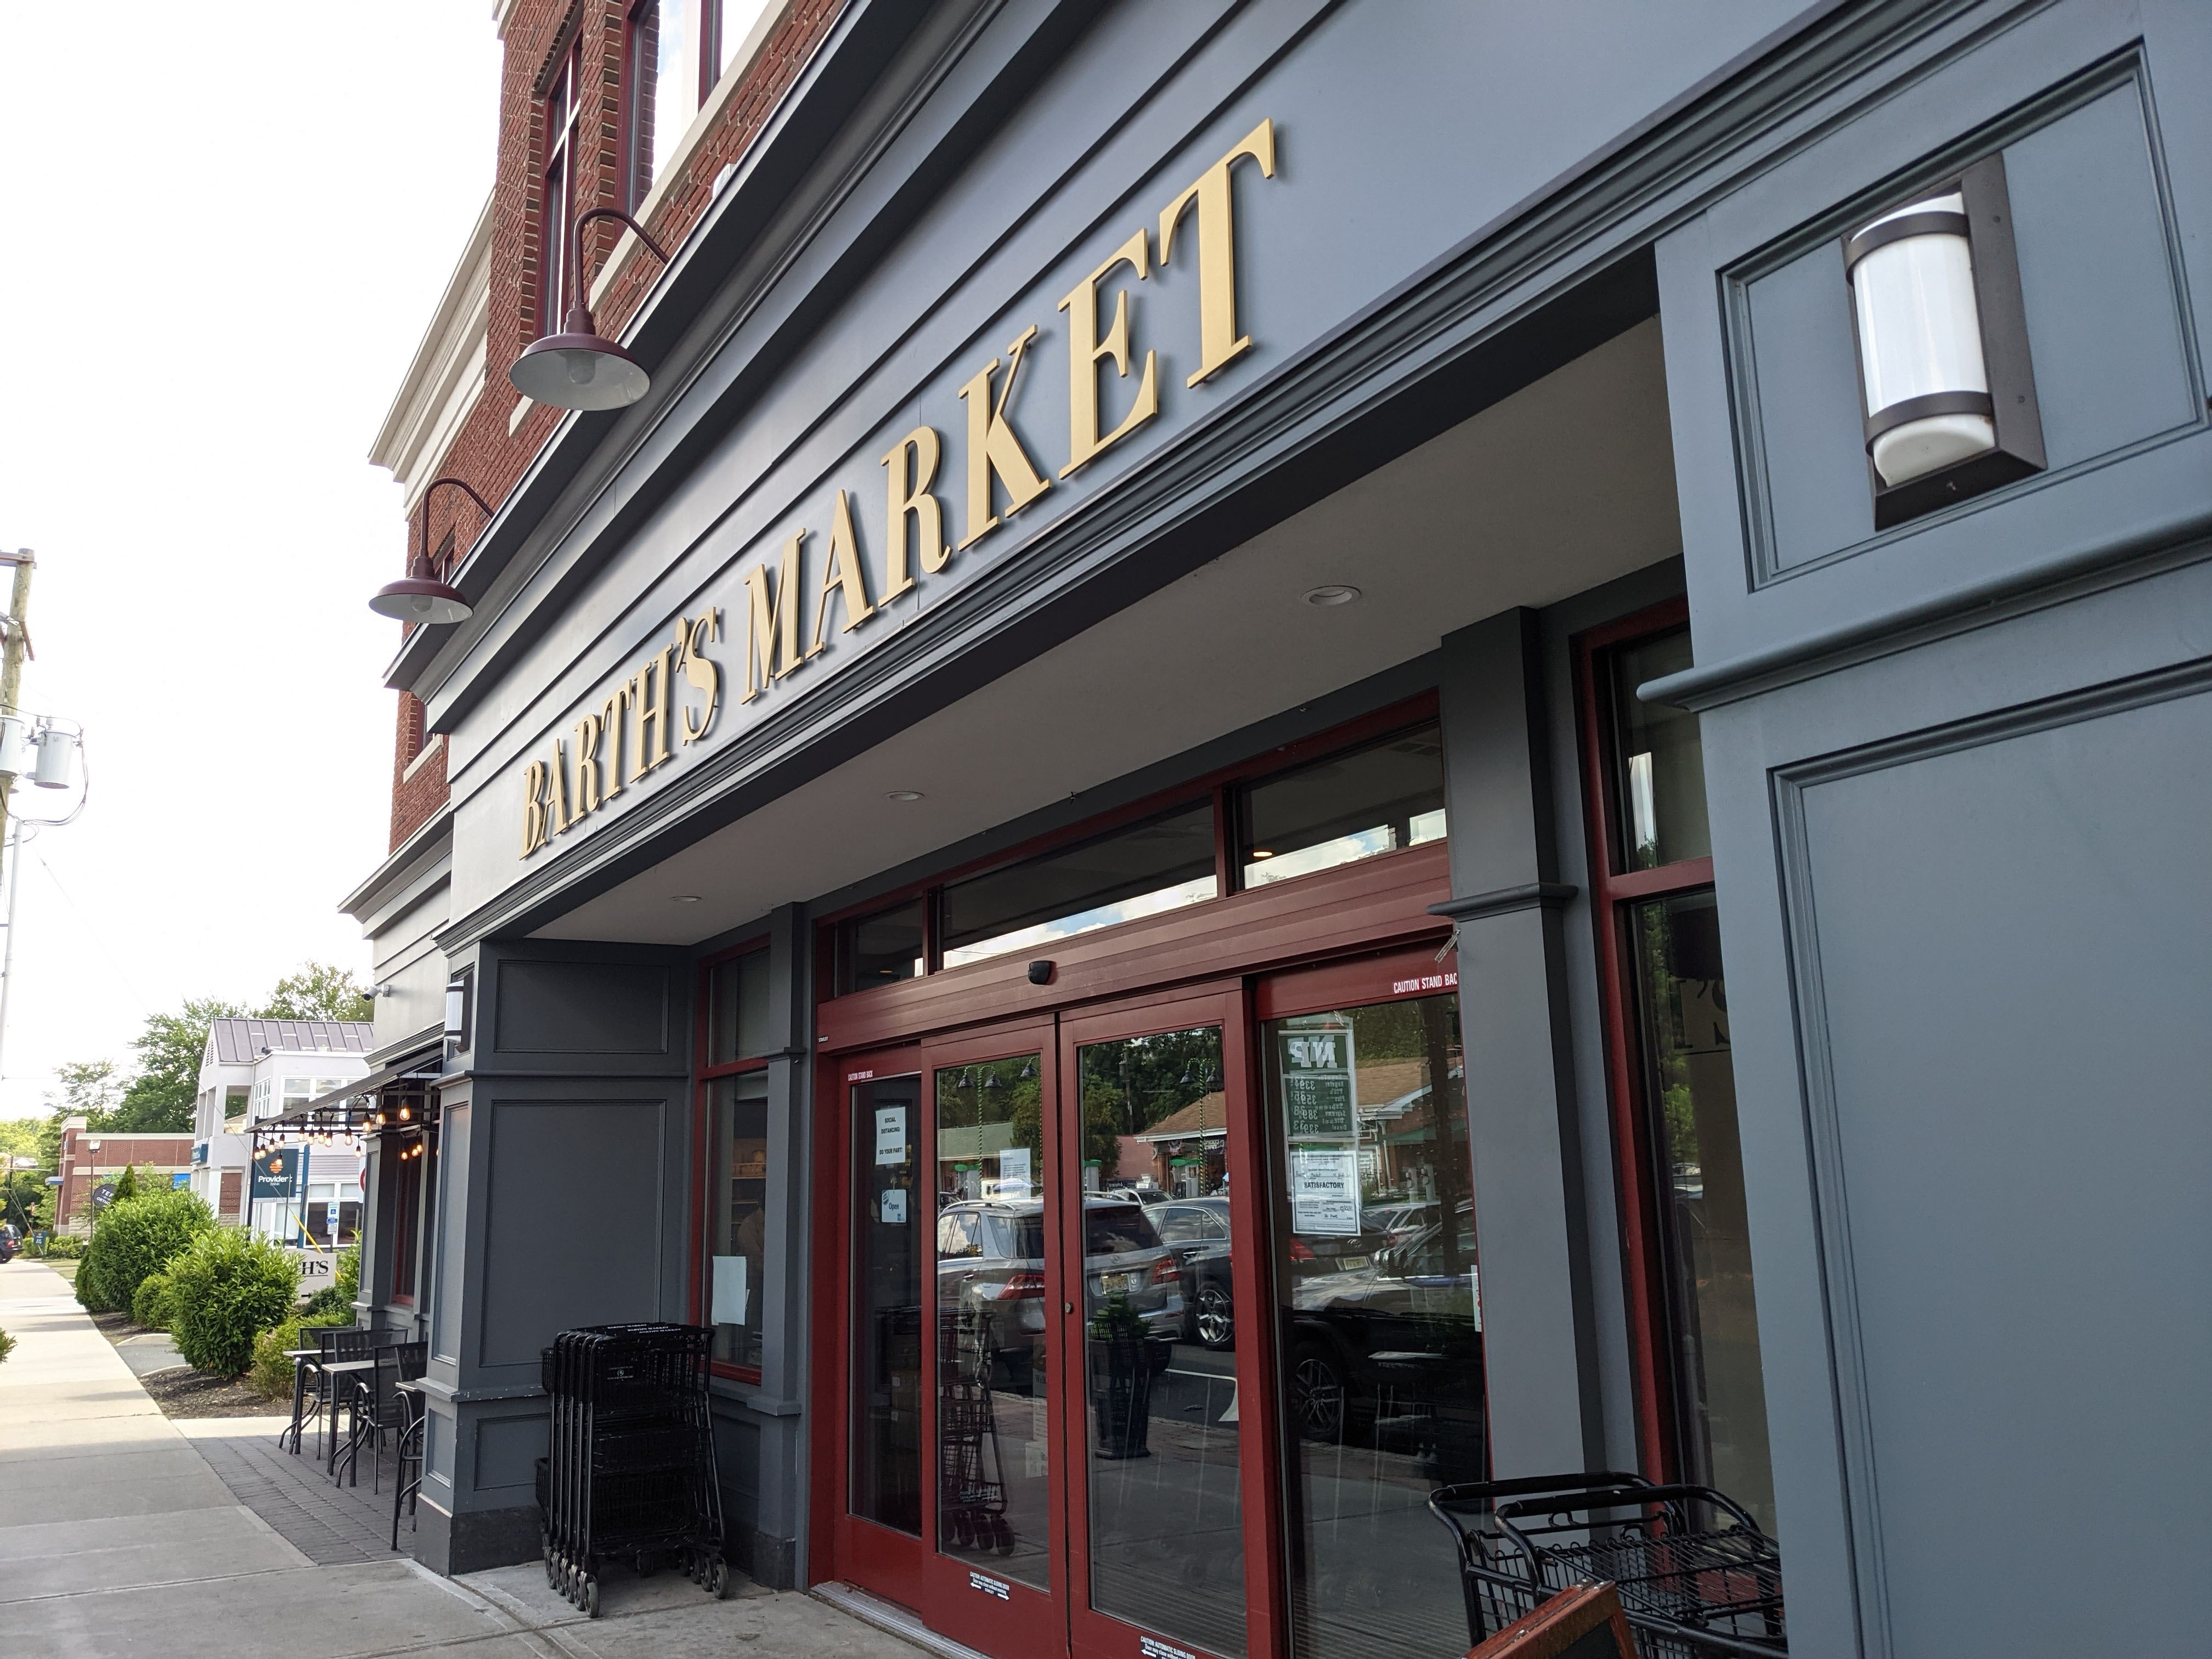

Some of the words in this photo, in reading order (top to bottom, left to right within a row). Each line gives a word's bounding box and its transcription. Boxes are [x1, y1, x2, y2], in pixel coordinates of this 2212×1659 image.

[518, 607, 718, 861] BARTH'S
[741, 117, 1275, 706] MARKET
[1393, 979, 1420, 994] CAUTION
[1422, 975, 1442, 990] STAND
[1444, 972, 1458, 986] BAC
[96, 1197, 110, 1205] ORTHO
[889, 1203, 899, 1211] Open
